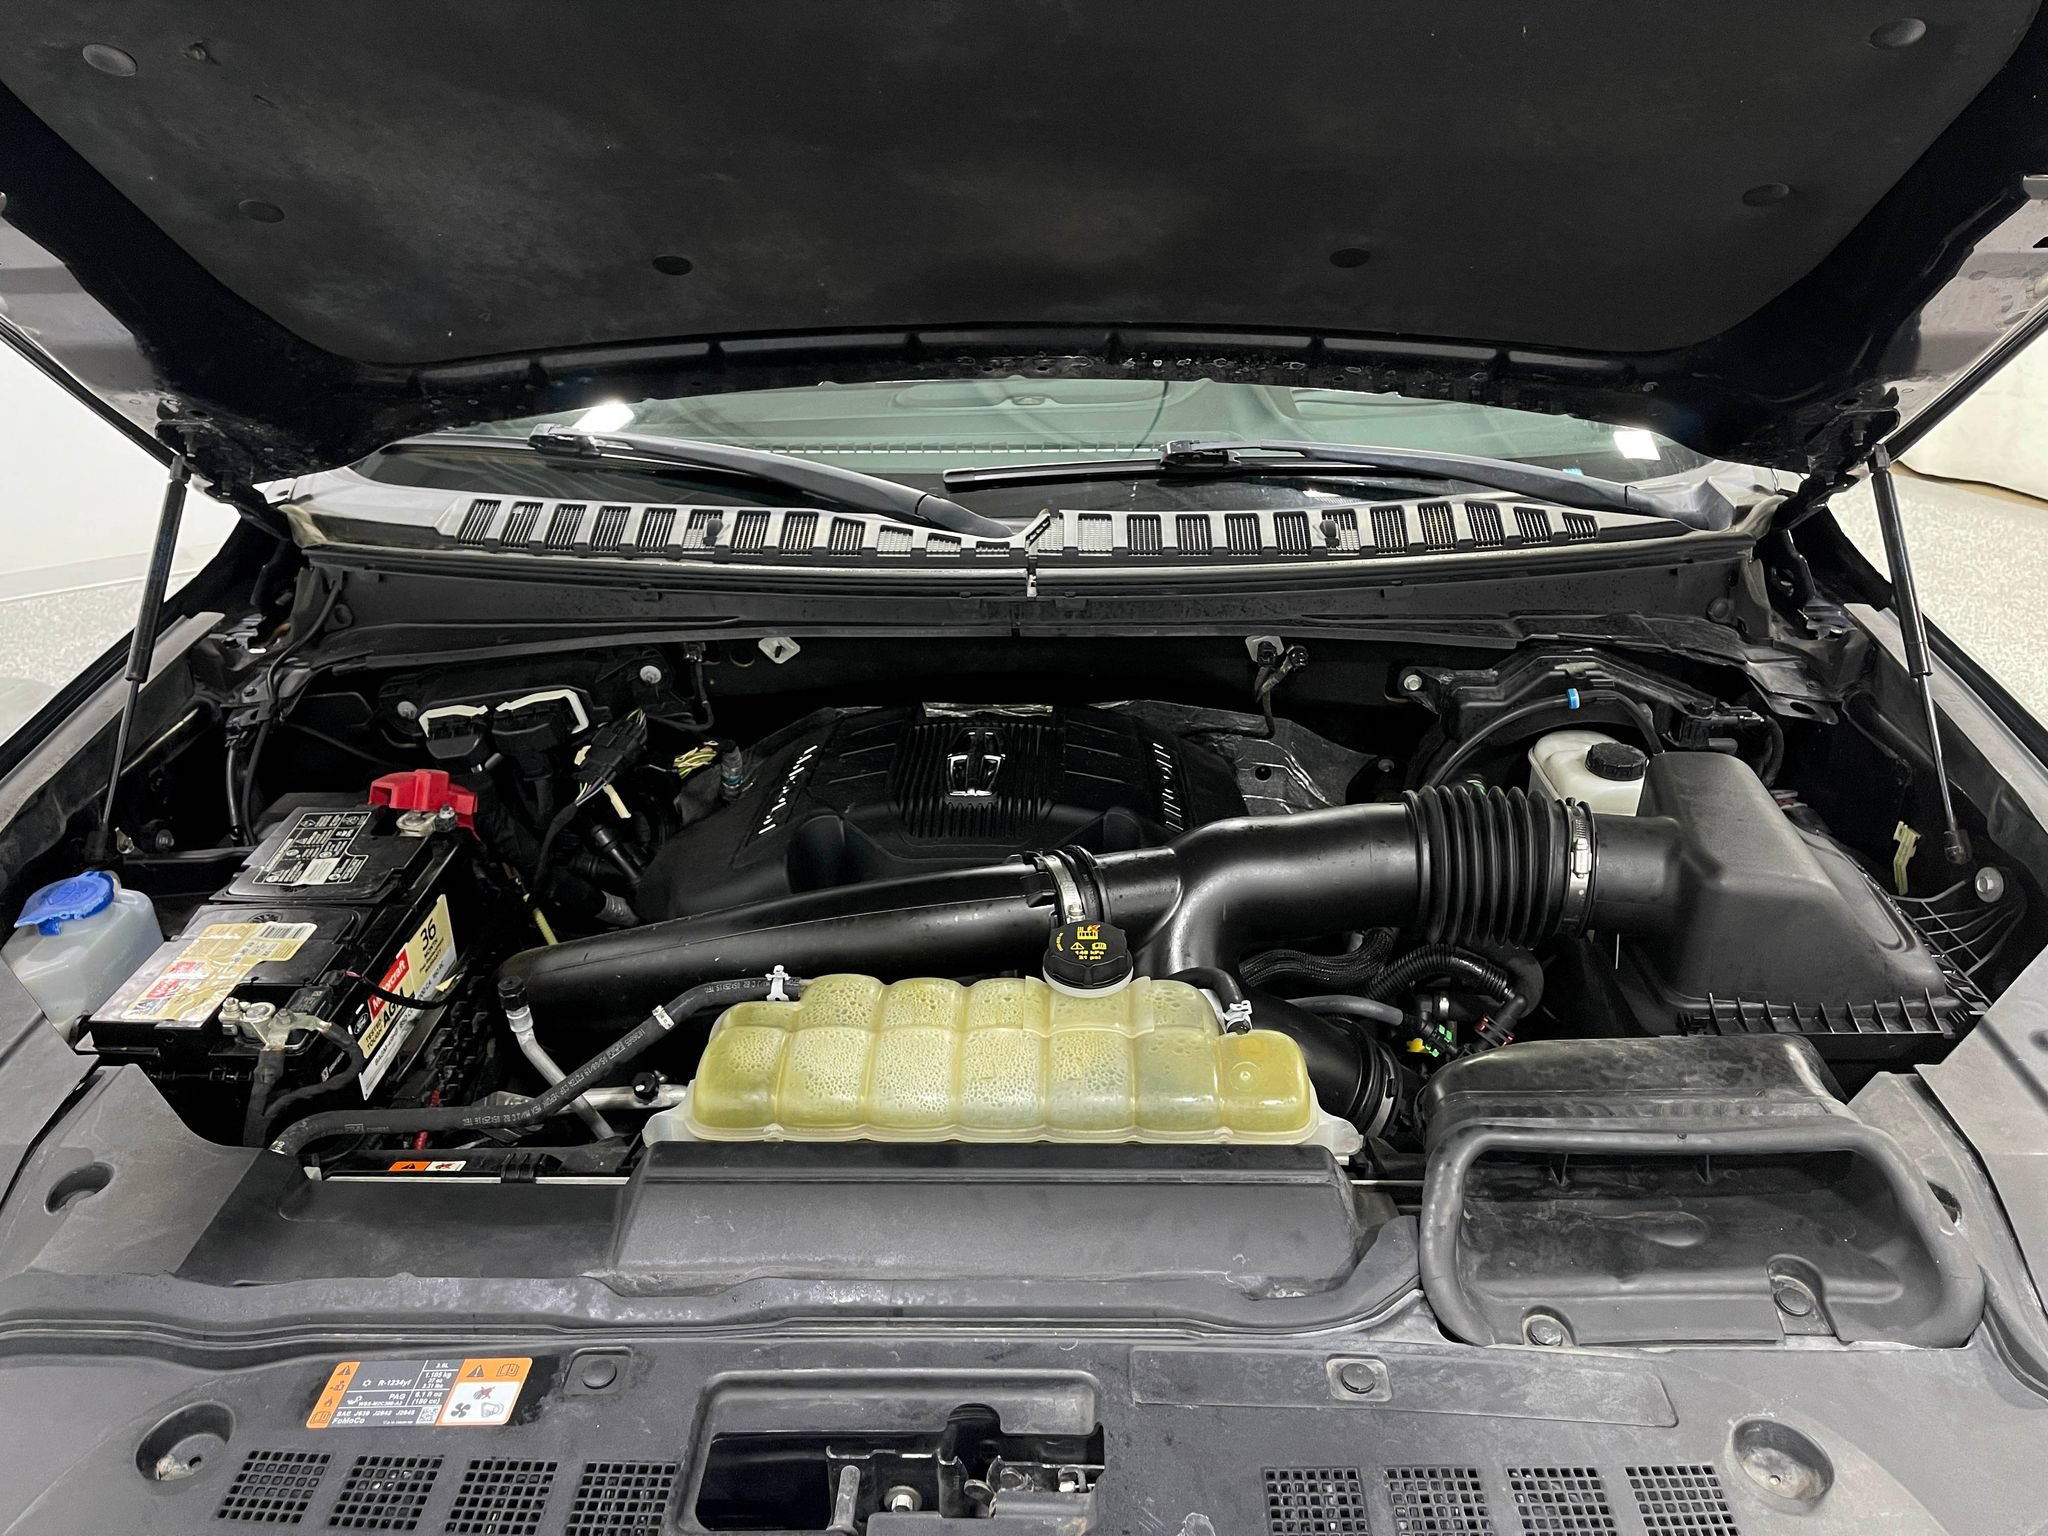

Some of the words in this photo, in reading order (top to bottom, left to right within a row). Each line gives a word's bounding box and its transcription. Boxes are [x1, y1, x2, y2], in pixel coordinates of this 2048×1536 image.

[420, 919, 437, 951] 36
[424, 938, 438, 958] MONTH
[372, 960, 406, 1009] Morcraft
[365, 1019, 382, 1042] TESTED
[377, 1379, 411, 1387] R-1234yf
